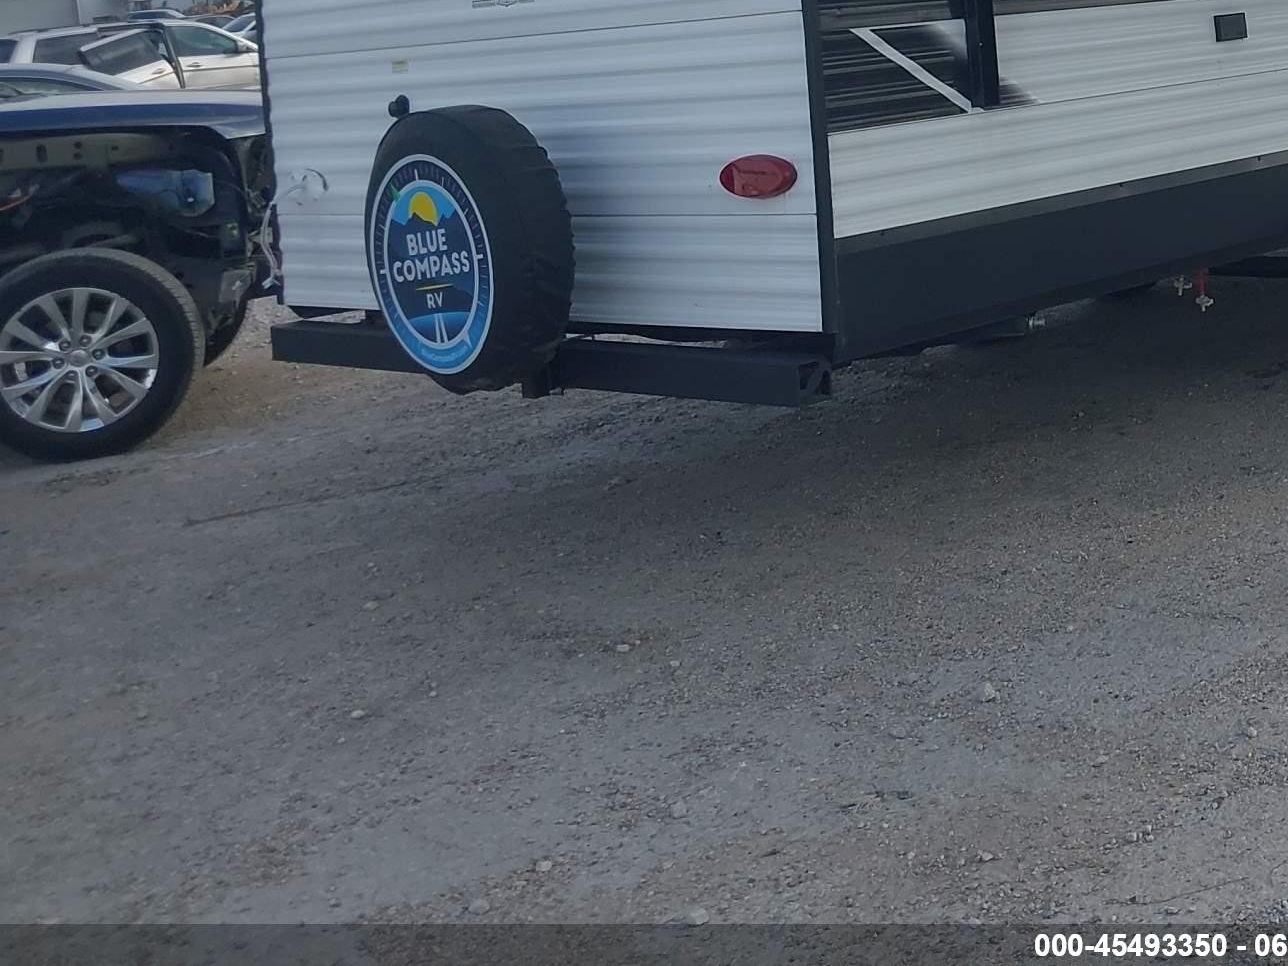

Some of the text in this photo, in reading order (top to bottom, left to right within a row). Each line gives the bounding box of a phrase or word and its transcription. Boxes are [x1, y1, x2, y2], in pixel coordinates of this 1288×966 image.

[406, 228, 448, 256] BLUE
[392, 251, 470, 283] COMPASS
[426, 292, 443, 309] RV
